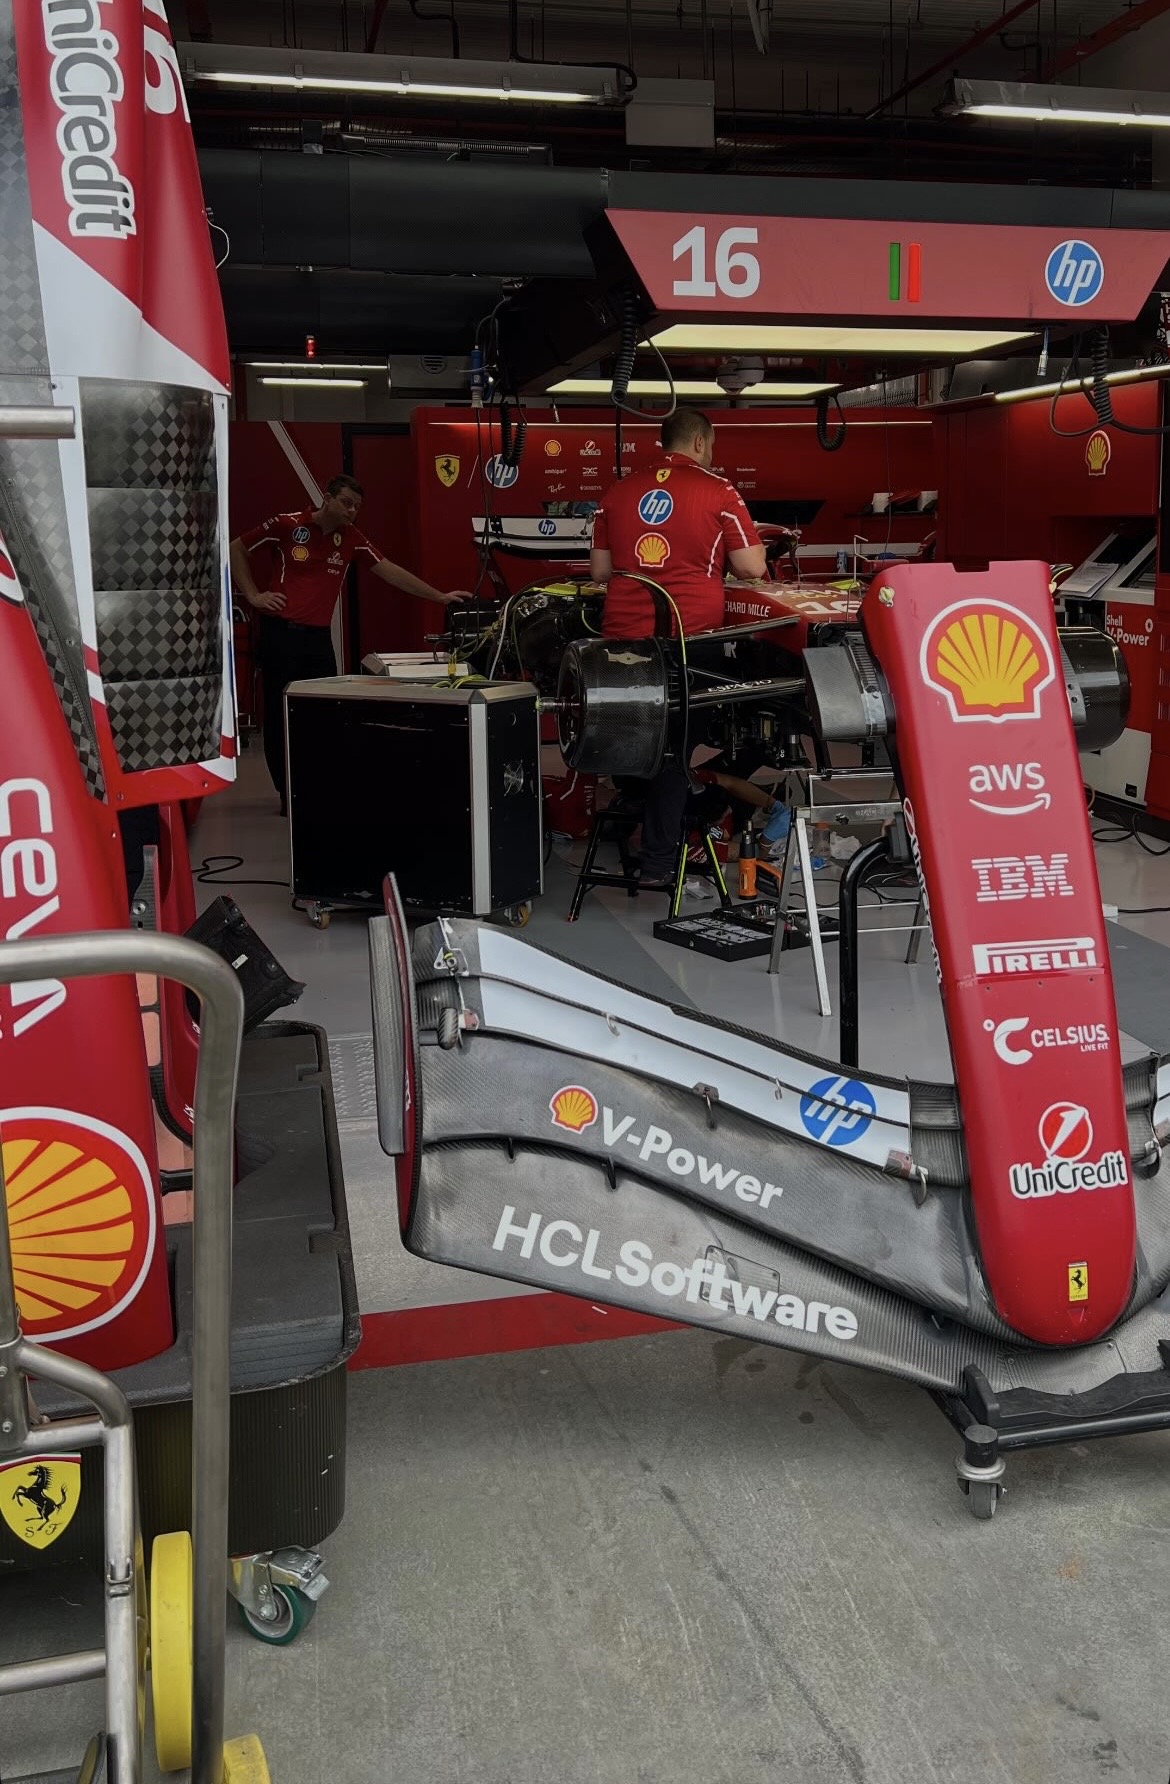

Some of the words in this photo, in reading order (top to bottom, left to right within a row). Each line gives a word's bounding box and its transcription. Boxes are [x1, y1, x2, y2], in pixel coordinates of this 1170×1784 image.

[43, 0, 134, 237] niCredit
[672, 225, 760, 298] 16
[1049, 240, 1100, 305] hp
[488, 454, 516, 487] hp
[641, 489, 671, 525] hp
[294, 527, 309, 543] hp
[539, 519, 556, 535] hp
[724, 601, 746, 614] CHARD
[747, 603, 771, 618] MILLE
[1106, 615, 1123, 627] Shell
[1106, 626, 1150, 647] V-Power
[969, 762, 1045, 792] aws
[971, 853, 1074, 902] IBM
[972, 936, 1096, 974] PIRELLI
[1031, 1023, 1109, 1048] CELSIUS
[1080, 1044, 1097, 1052] LIVE
[1098, 1042, 1108, 1050] FIT
[803, 1076, 874, 1145] hp
[602, 1106, 784, 1209] V-Power
[1011, 1153, 1126, 1197] UniCredit
[491, 1205, 858, 1340] HCLSoftware
